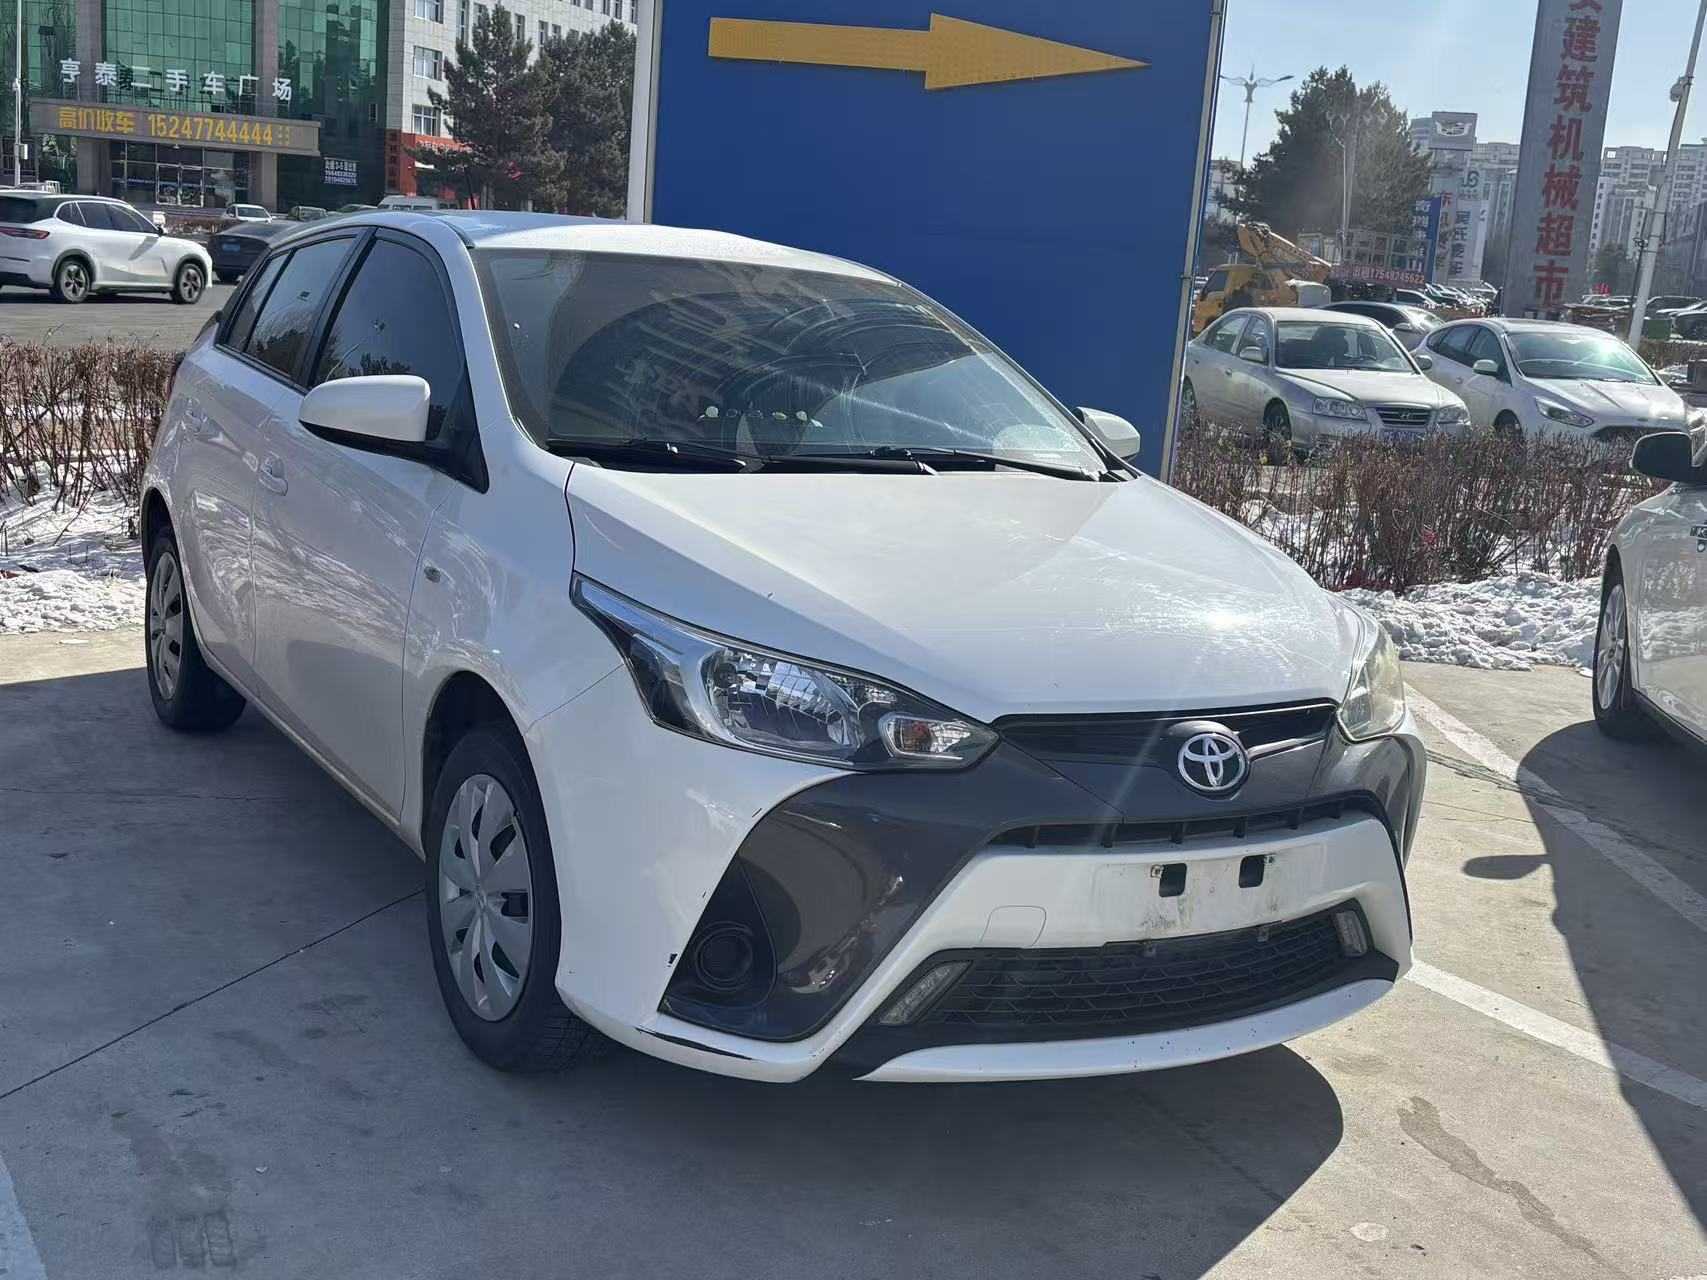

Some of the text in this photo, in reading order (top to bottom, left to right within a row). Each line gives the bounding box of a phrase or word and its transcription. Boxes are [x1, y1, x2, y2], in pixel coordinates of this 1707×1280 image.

[60, 58, 292, 101] 亨泰二手车广场
[148, 114, 273, 145] 15247744444
